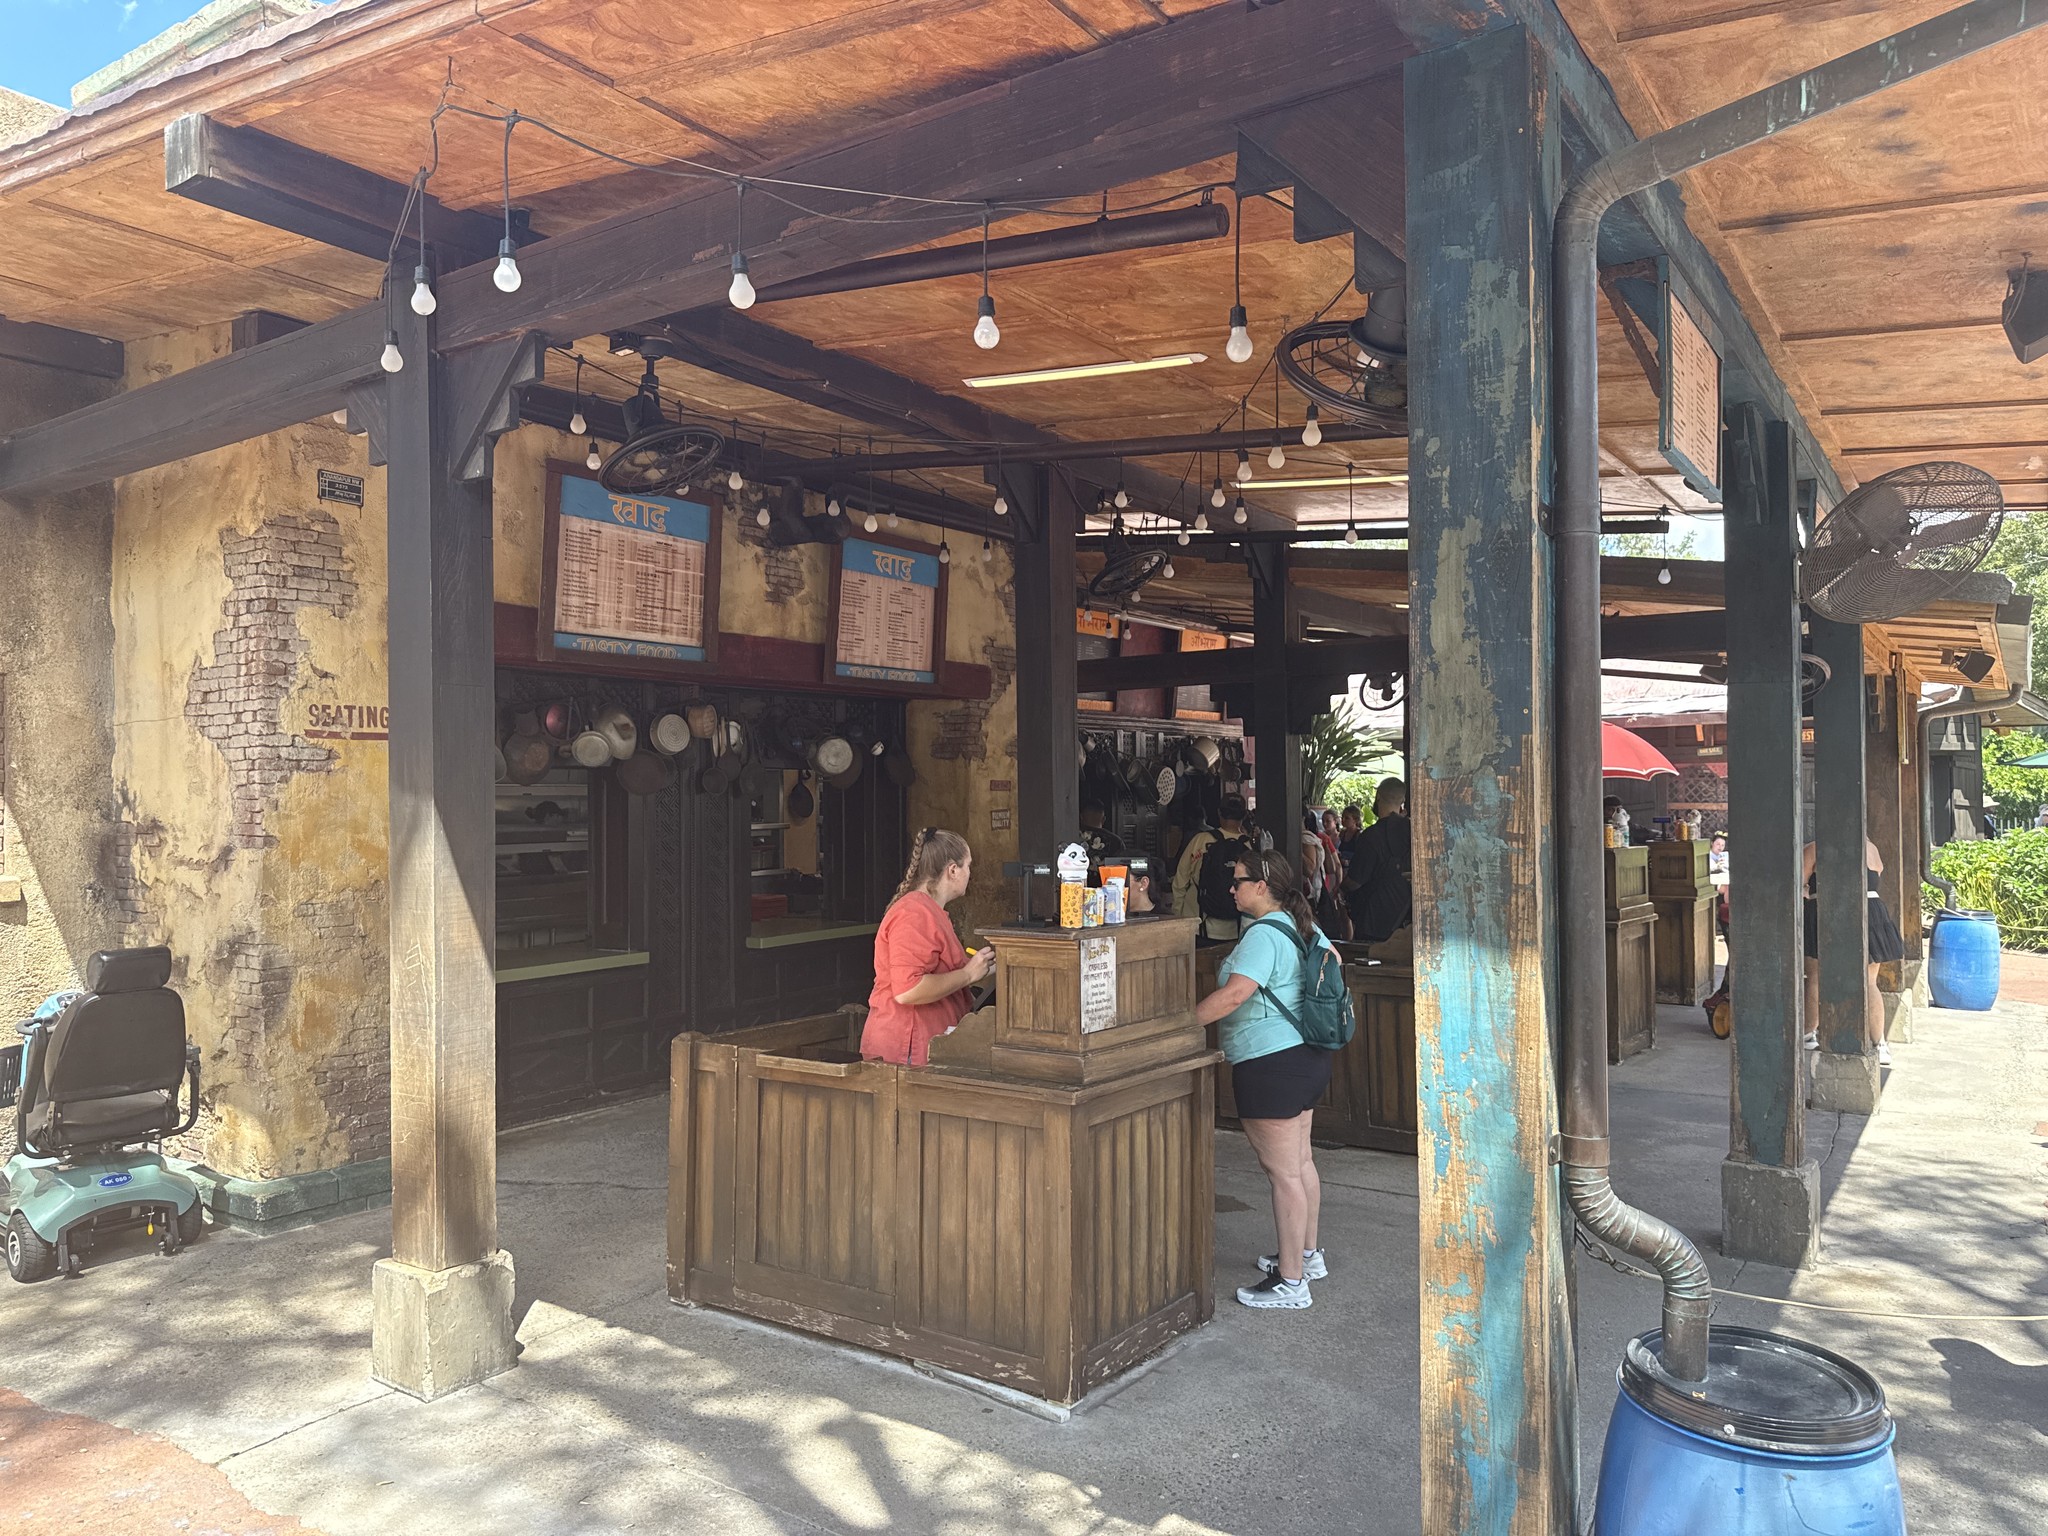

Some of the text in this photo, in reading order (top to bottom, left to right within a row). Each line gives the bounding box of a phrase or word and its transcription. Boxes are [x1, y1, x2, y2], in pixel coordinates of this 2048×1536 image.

[576, 637, 677, 660] TASTY FOOD
[308, 703, 389, 729] SEATING
[1088, 962, 1108, 972] CASHLESS
[1083, 971, 1113, 982] PAYMENT ONLY
